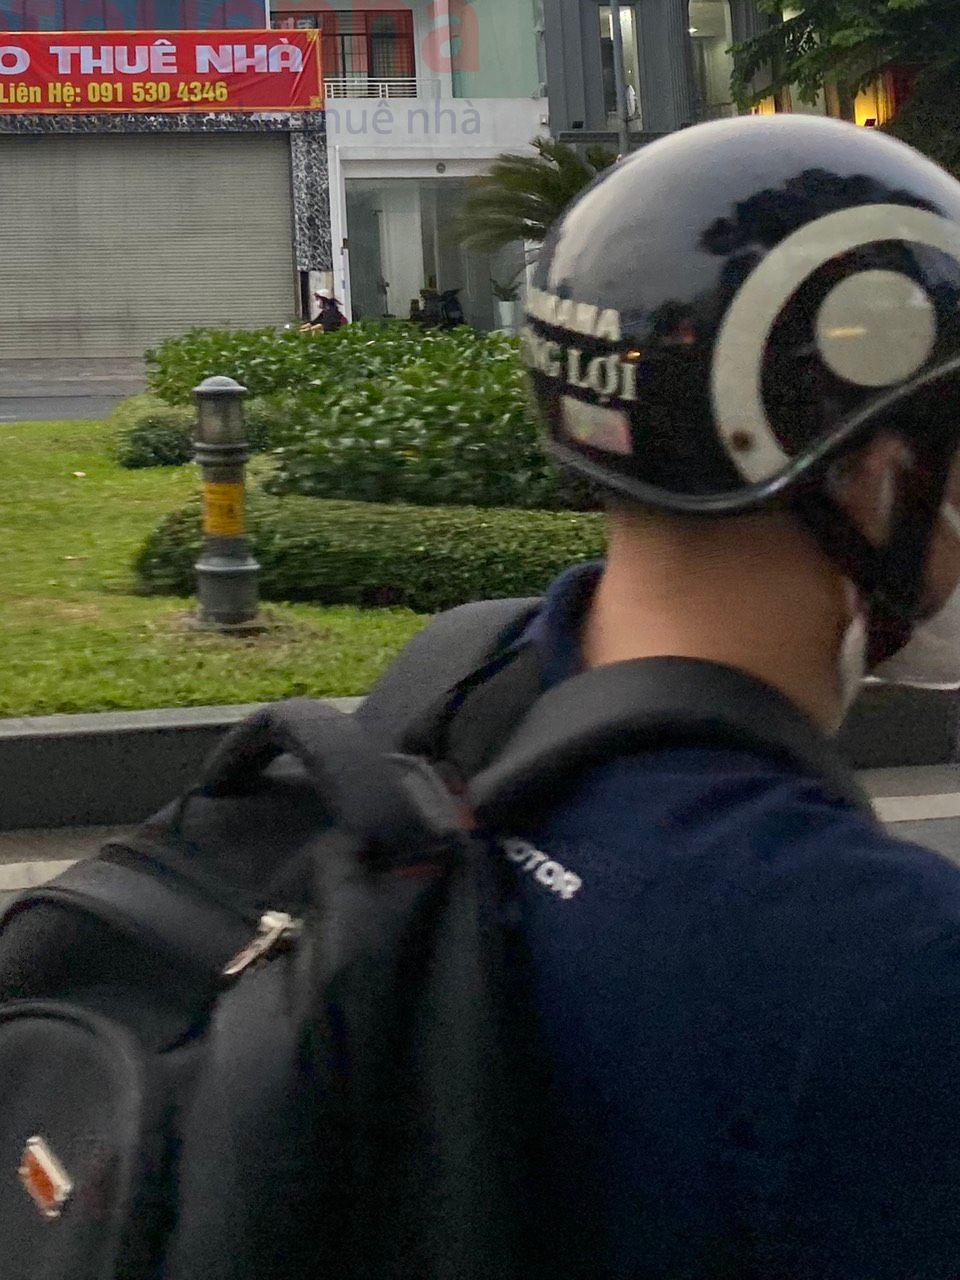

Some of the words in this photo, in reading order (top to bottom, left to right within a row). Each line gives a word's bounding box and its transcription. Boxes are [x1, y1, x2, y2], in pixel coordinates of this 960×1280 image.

[49, 38, 178, 75] THUÊ
[195, 37, 303, 74] NHÀ
[47, 81, 81, 108] Hệ:
[87, 82, 124, 104] 091
[132, 81, 171, 103] 530
[177, 80, 228, 103] 4346
